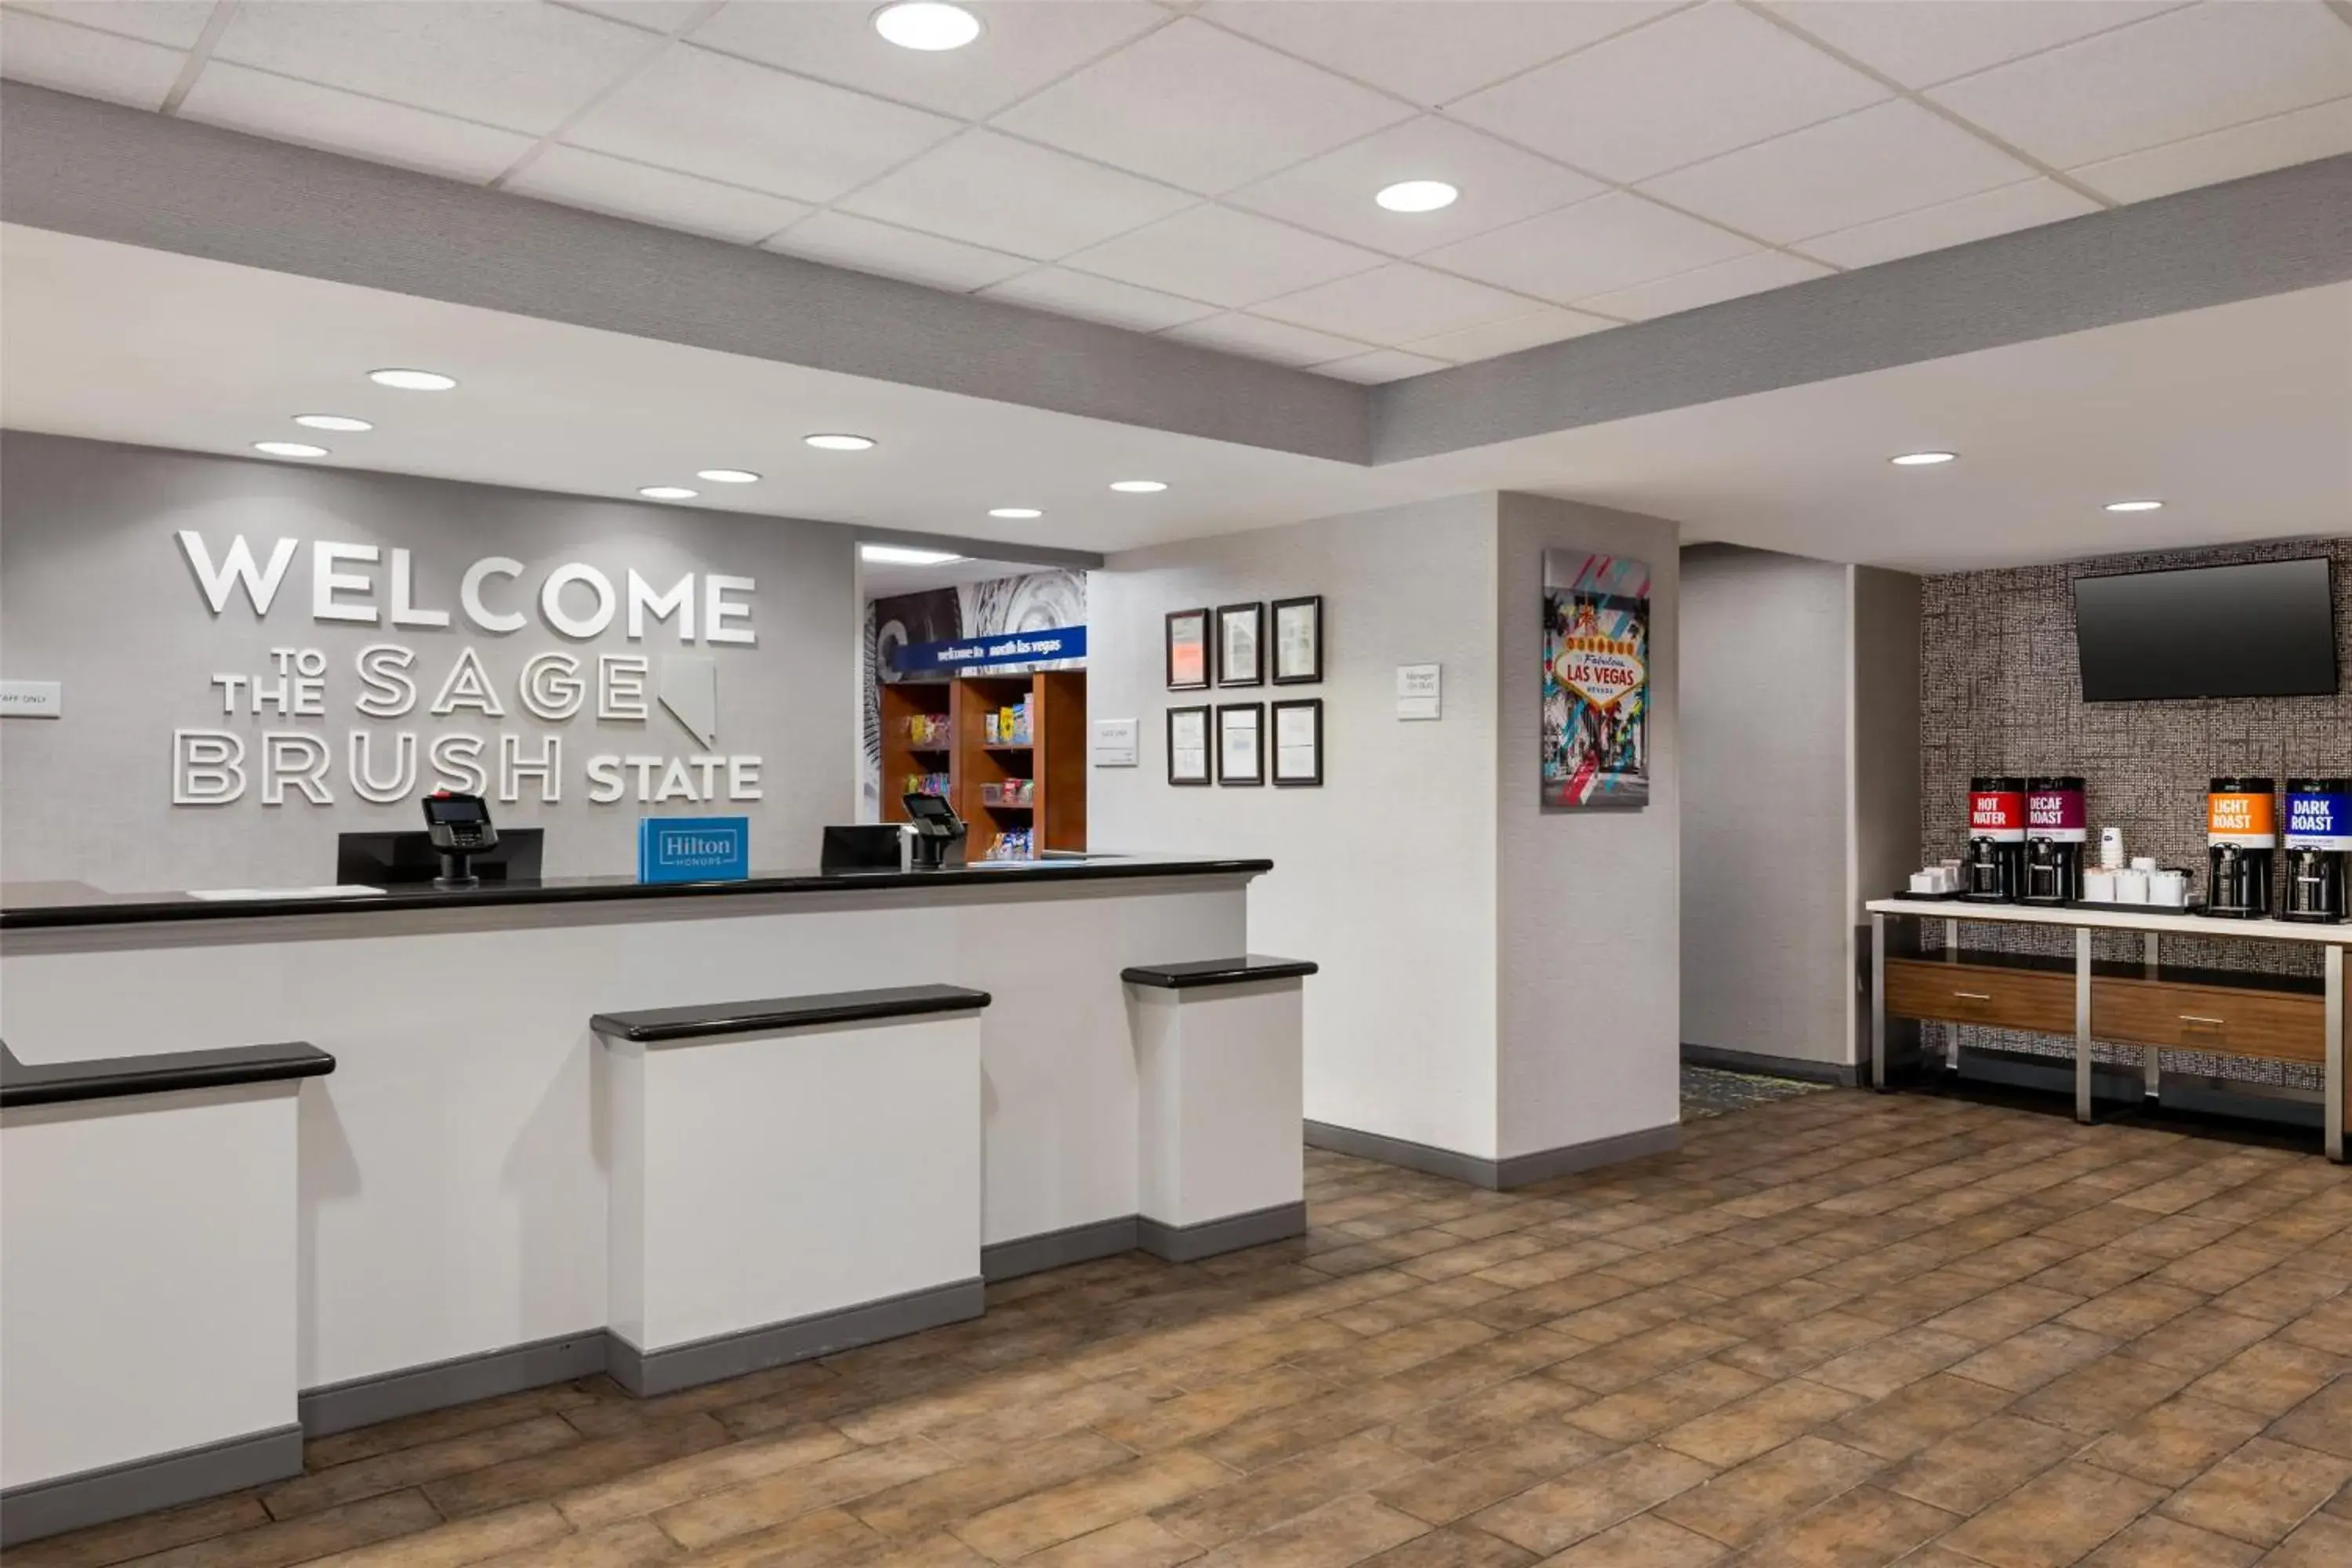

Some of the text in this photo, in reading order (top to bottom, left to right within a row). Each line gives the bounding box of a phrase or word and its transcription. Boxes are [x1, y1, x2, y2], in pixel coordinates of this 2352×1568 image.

[176, 530, 756, 643] WELCOME
[1033, 639, 1062, 655] vegas
[270, 648, 327, 677] TO
[354, 643, 648, 720] SAGE
[1566, 664, 1635, 686] LAS VEGAS
[210, 674, 325, 717] THE
[172, 728, 764, 805] BRUSH STATE
[1977, 797, 1998, 811] HOT
[2030, 797, 2063, 810] DECAF
[2213, 798, 2249, 814] LIGHT
[2293, 800, 2330, 815] DARK
[1973, 811, 2006, 825] WATER
[2030, 811, 2063, 825] ROAST
[2212, 815, 2252, 829] ROAST
[2291, 815, 2334, 831] ROAST
[666, 836, 731, 855] Hilton
[676, 857, 722, 866] HONORS
